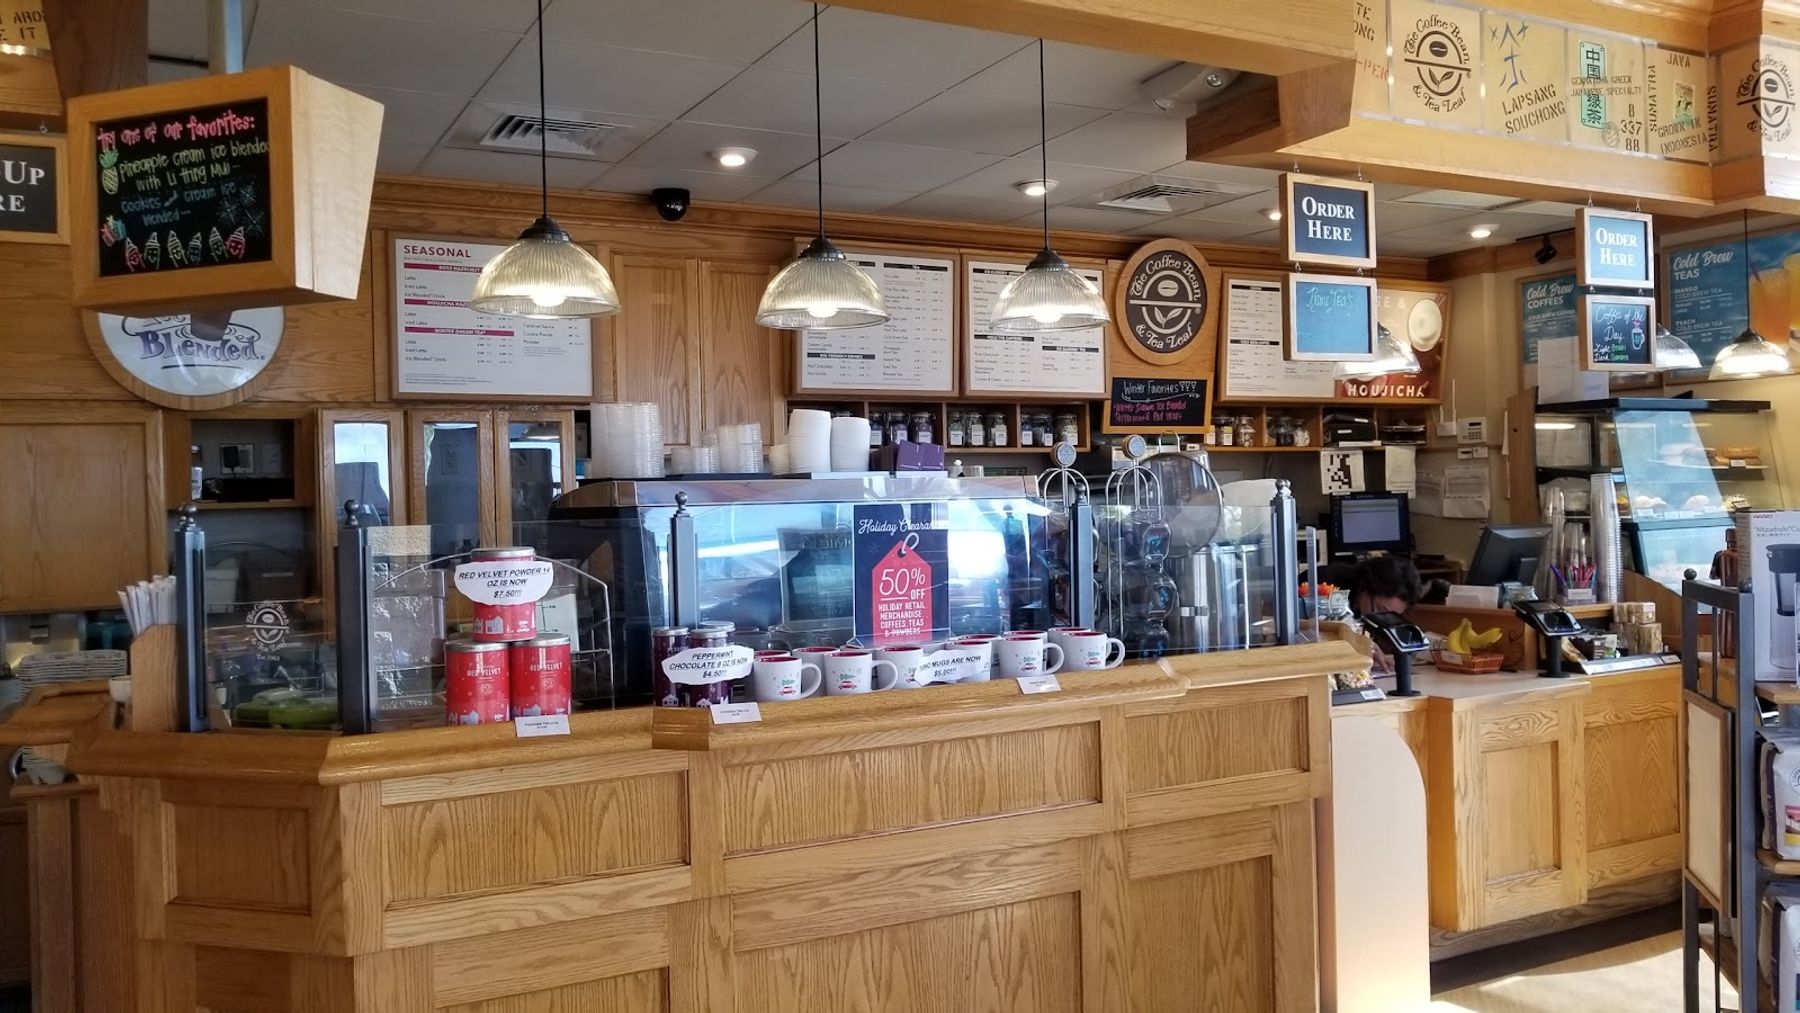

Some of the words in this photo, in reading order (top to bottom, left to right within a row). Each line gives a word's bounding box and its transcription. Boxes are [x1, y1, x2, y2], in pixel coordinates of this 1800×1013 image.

[14, 10, 45, 24] ARO
[1404, 32, 1418, 54] The
[1416, 14, 1448, 32] Coffee
[1450, 22, 1470, 65] Bean
[1667, 53, 1691, 68] JAVA
[1413, 85, 1422, 97] &
[1423, 93, 1440, 112] Tea
[1442, 87, 1466, 112] Leaf
[1502, 84, 1556, 116] LAPSANG
[1504, 101, 1565, 134] SOUCHONG
[1707, 86, 1718, 152] SUMATRA
[1658, 121, 1685, 138] GROWN
[1661, 133, 1709, 154] INDONESIA
[1302, 196, 1355, 220] ORDER
[1306, 219, 1352, 241] HERE
[1596, 228, 1637, 247] ORDER
[404, 245, 472, 258] SEASONAL
[1600, 248, 1635, 266] HERE
[1673, 252, 1700, 271] Cold
[1702, 251, 1733, 267] Brew
[1130, 273, 1147, 297] The
[1146, 254, 1181, 272] Coffee
[1183, 262, 1201, 300] Bean
[1674, 269, 1700, 281] TEAS
[1527, 284, 1548, 300] Cold
[1549, 283, 1574, 296] Brew
[1528, 296, 1564, 309] COFFEES
[1135, 324, 1145, 338] &
[1146, 332, 1164, 349] Tea
[1167, 322, 1193, 349] Leaf
[1604, 325, 1624, 344] Day
[1123, 380, 1145, 395] Winter
[1348, 384, 1424, 398] HOUJICHA
[858, 518, 898, 536] Holiday
[478, 570, 509, 578] VELVET
[509, 568, 541, 577] POWDER
[509, 578, 527, 586] NOW
[880, 568, 926, 596] 50%
[911, 588, 926, 600] OFF
[878, 603, 903, 611] HOLIDAY
[906, 602, 926, 610] RETAIL
[908, 619, 924, 627] TEAS
[692, 651, 734, 660] PEPPERMINT
[932, 659, 950, 667] MUGS
[964, 655, 982, 663] NOW
[481, 667, 501, 676] VELVET
[544, 662, 563, 671] VELVET
[669, 662, 716, 670] CHOCOLATE
